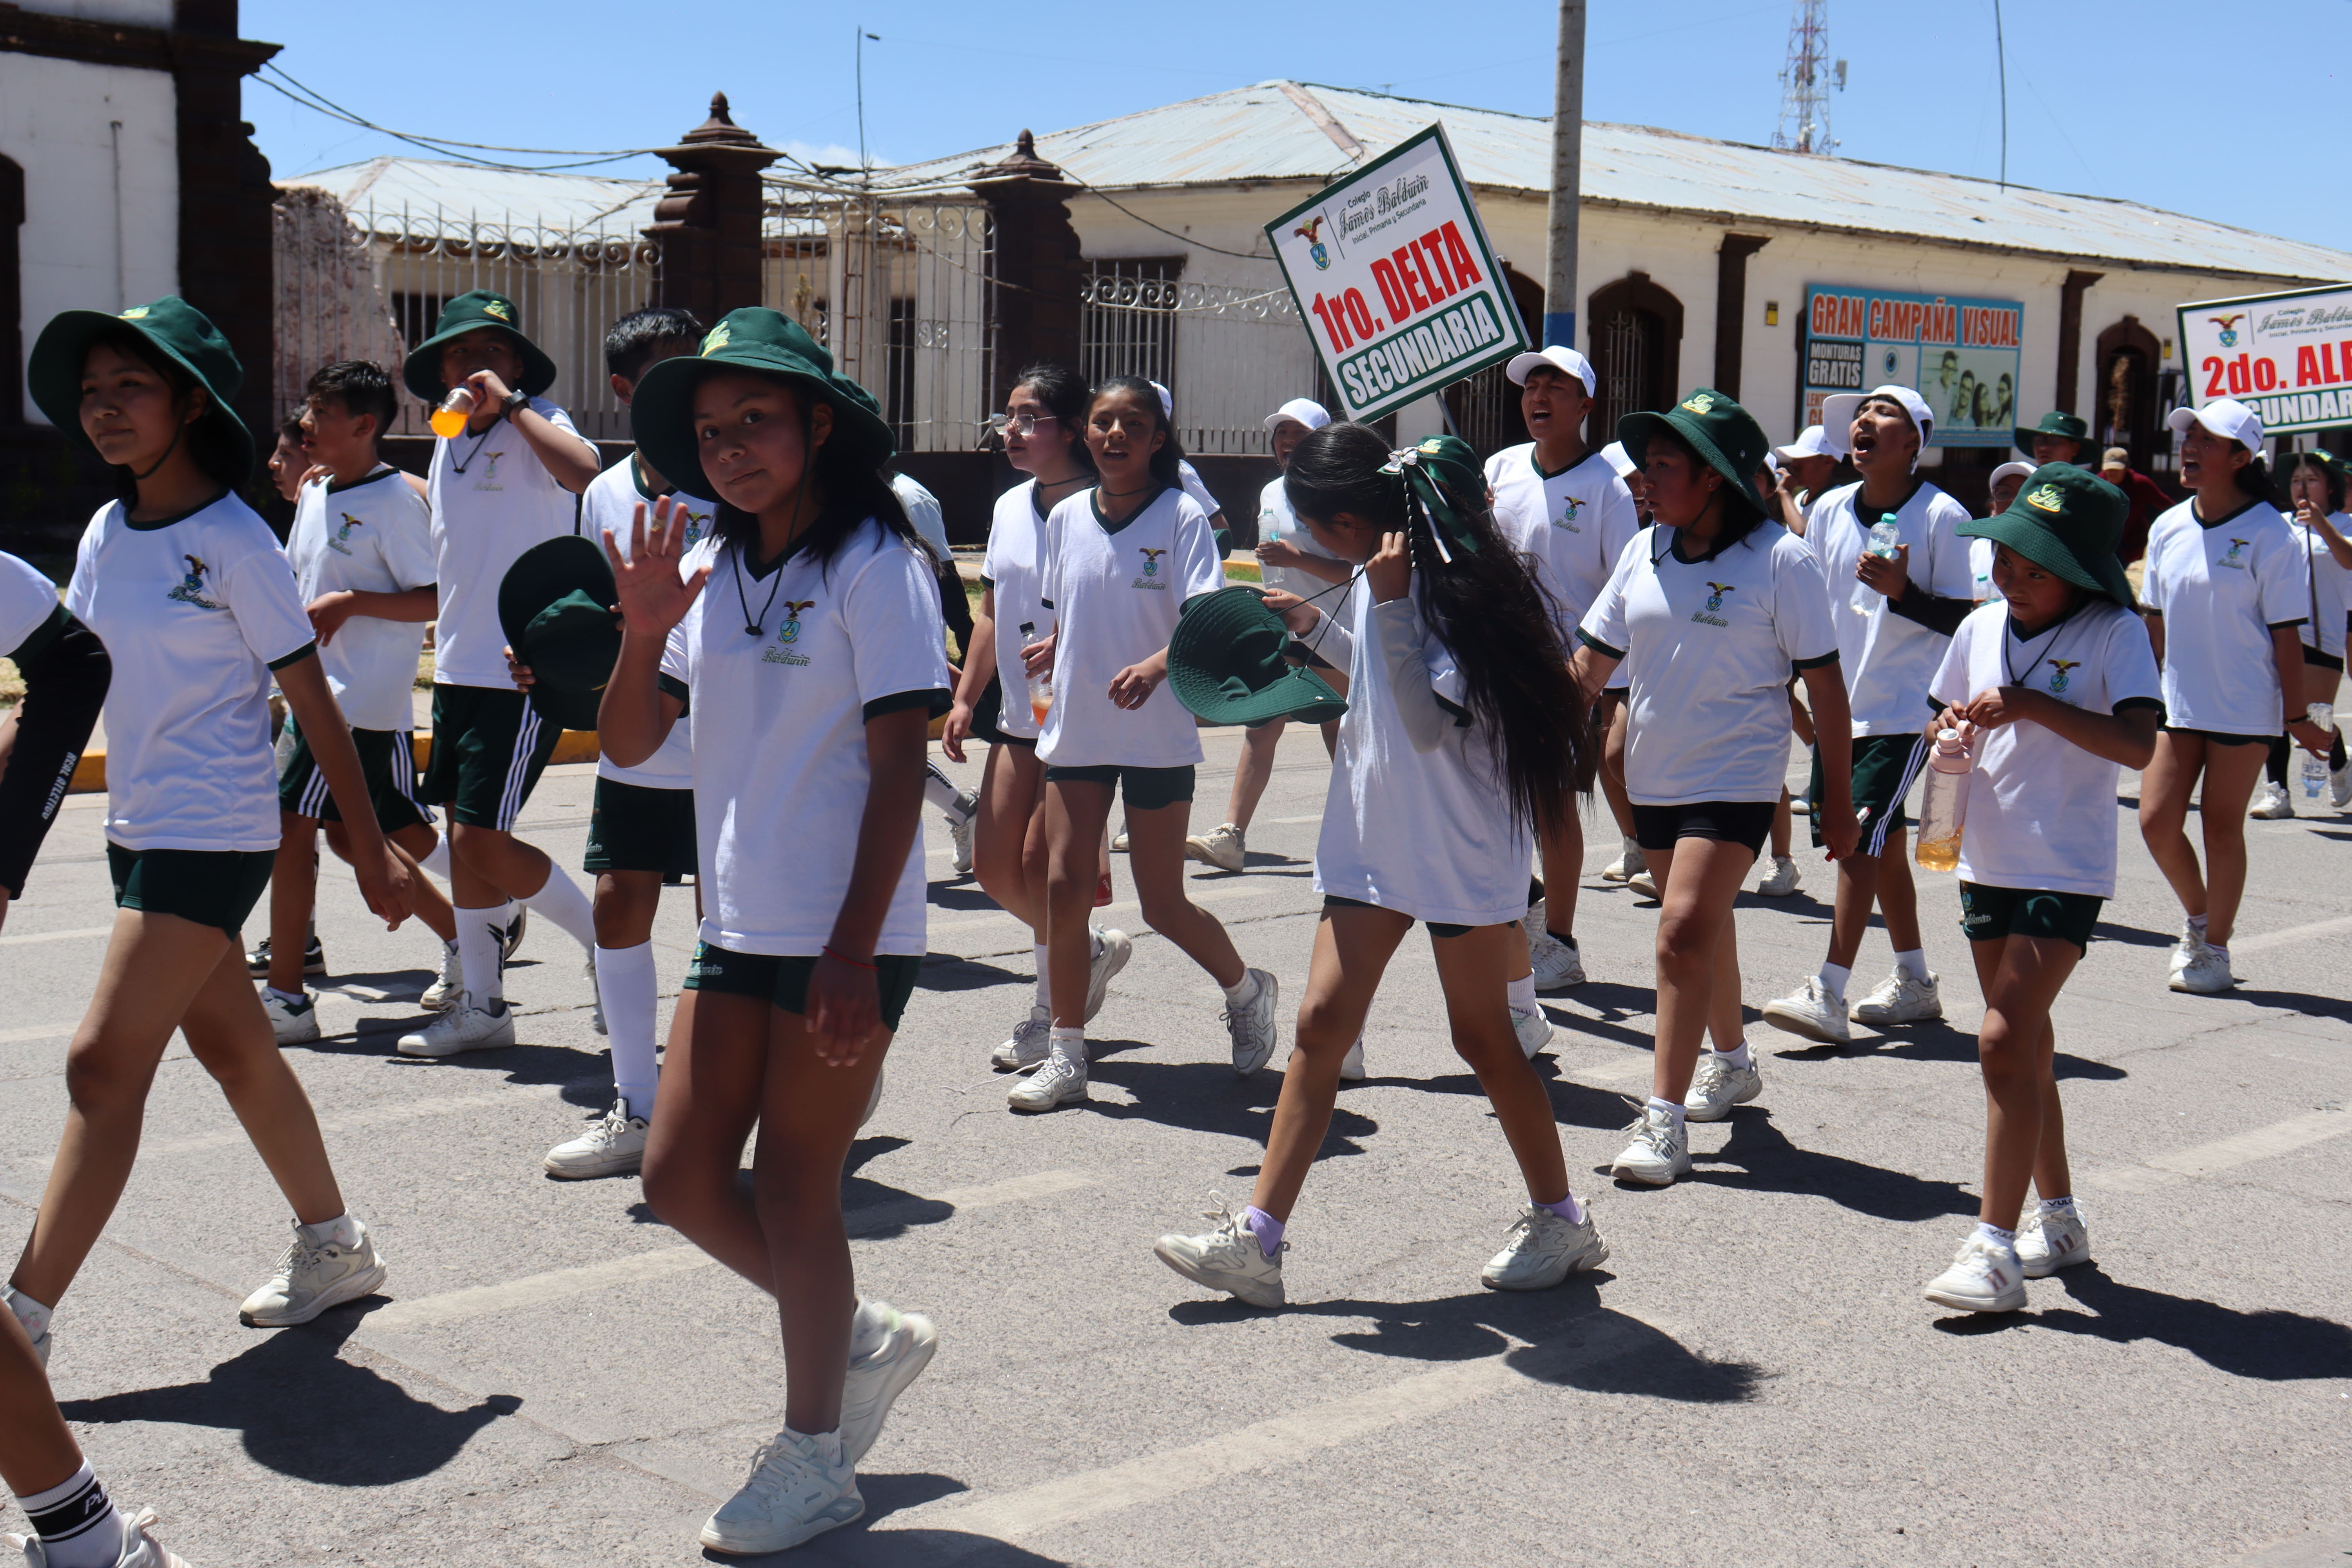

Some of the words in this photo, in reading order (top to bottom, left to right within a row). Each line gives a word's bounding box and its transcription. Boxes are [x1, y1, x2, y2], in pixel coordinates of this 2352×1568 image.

[1339, 203, 1375, 241] James
[1376, 174, 1429, 216] Baldwin
[1347, 190, 1371, 209] Colegio
[1368, 218, 1392, 235] Primaria
[1392, 215, 1397, 224] y
[1396, 198, 1427, 220] Secundaria
[1312, 287, 1385, 355] 1ro.
[1370, 220, 1483, 325] DELTA
[1811, 293, 1865, 339] GRAN
[1868, 297, 1957, 345] CAMPAÑA
[1962, 305, 2020, 348] VISUAL
[2277, 307, 2306, 316] Colegio
[2257, 314, 2305, 333] James
[1342, 297, 1501, 405] SECUNDARIA
[1810, 343, 1862, 361] MONTURAS
[1808, 359, 1861, 387] GRATIS
[2202, 353, 2288, 397] 2do.
[1806, 392, 1829, 407] LENT
[1552, 518, 1581, 534] Baldwin
[1131, 578, 1166, 590] Baldwin
[1691, 611, 1729, 628] Baldwin
[762, 646, 811, 667] Baldwin
